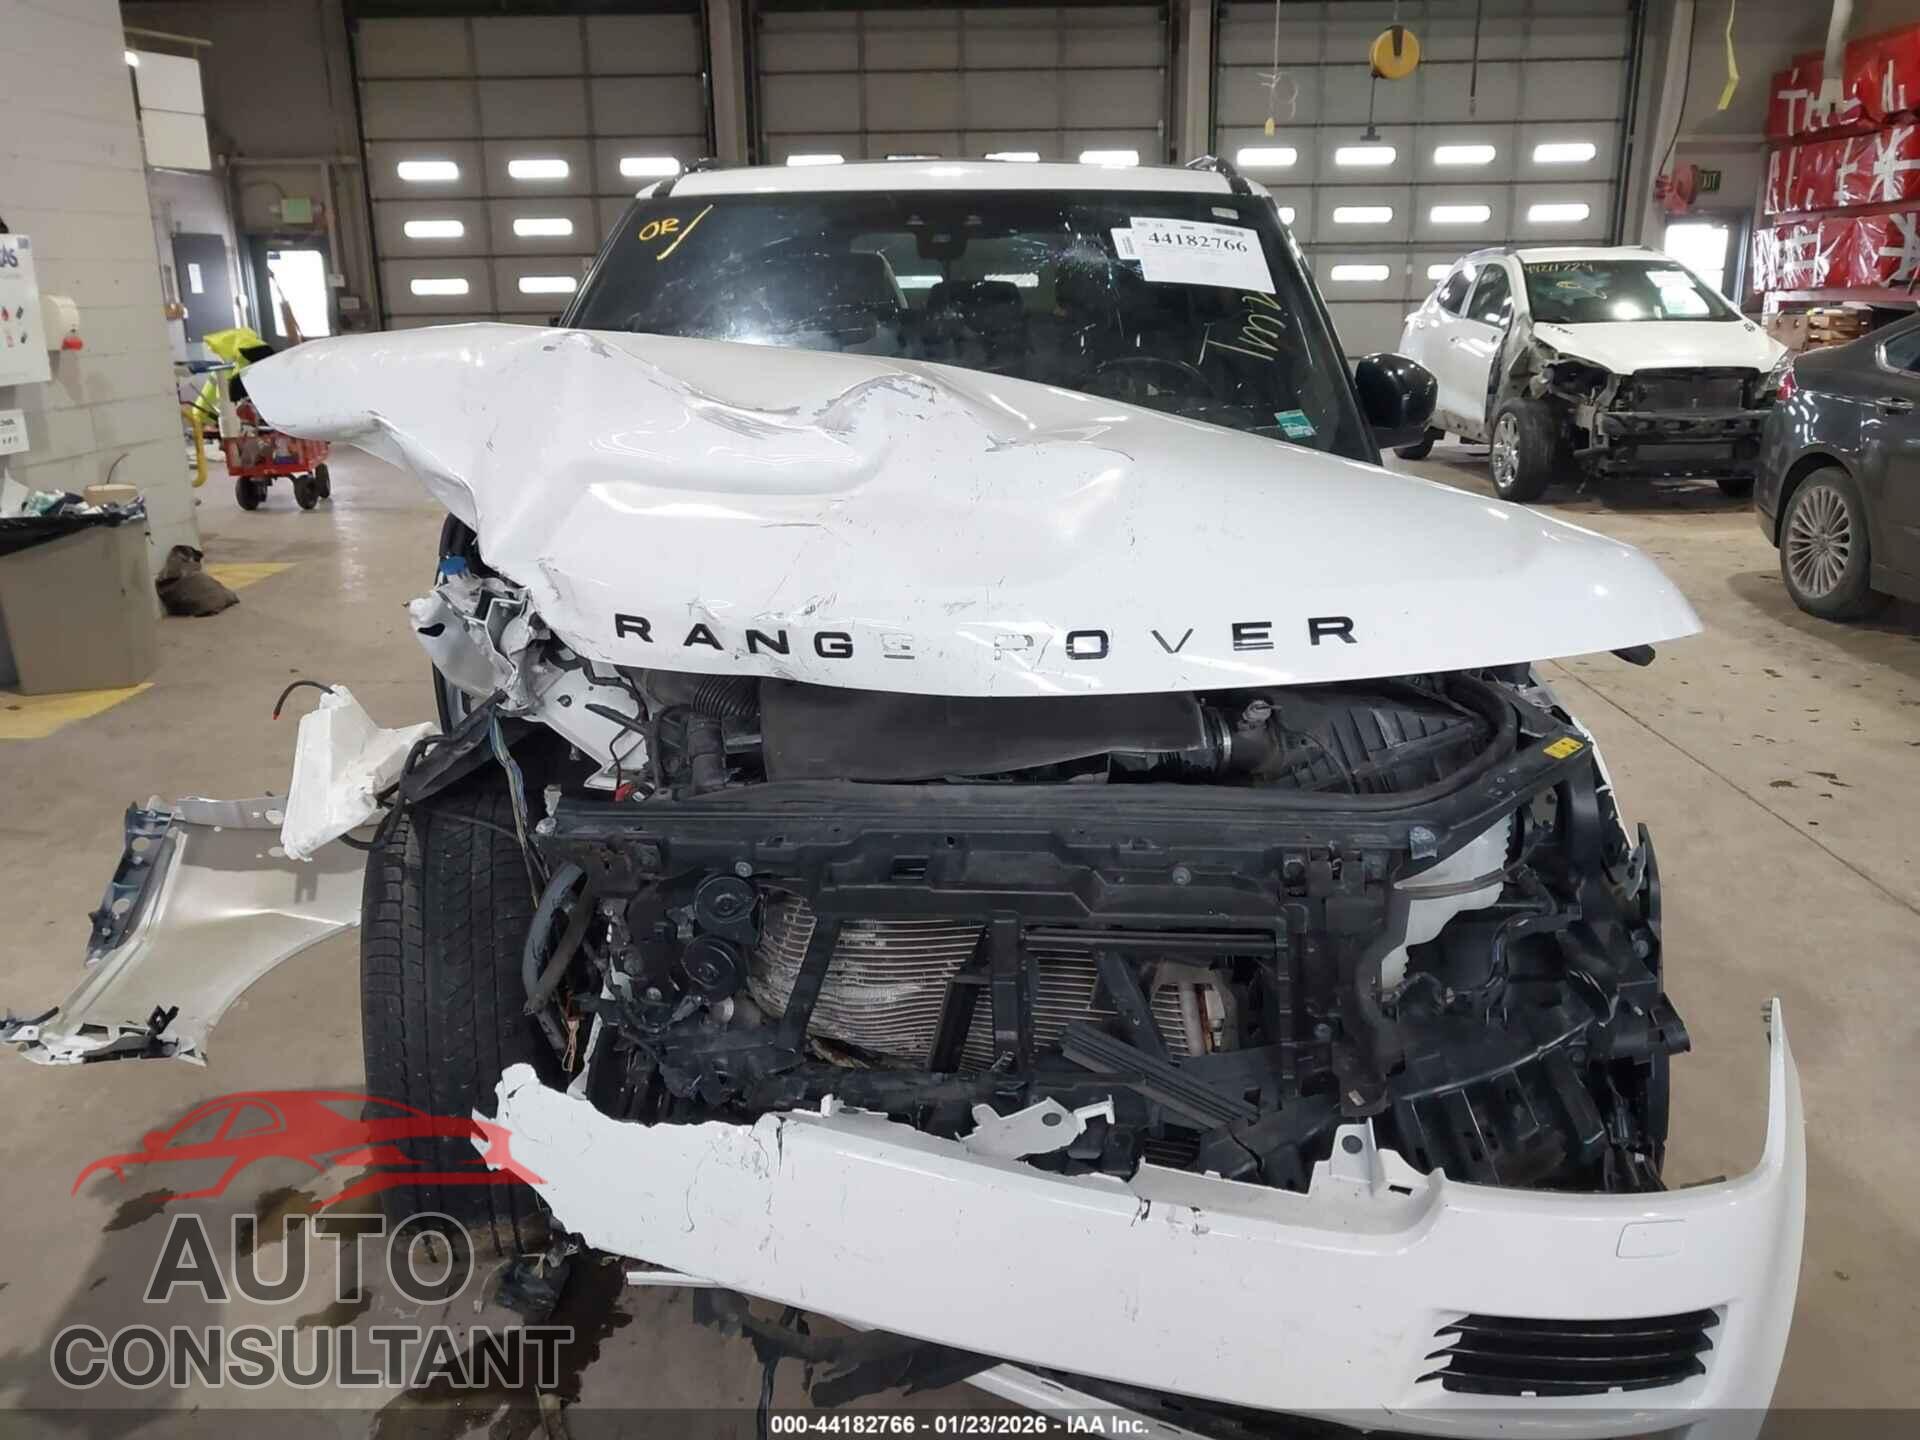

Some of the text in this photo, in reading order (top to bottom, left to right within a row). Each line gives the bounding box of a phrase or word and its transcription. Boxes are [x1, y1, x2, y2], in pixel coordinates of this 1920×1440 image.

[1148, 231, 1248, 254] 44182766
[614, 613, 1358, 661] RANGE ROVER
